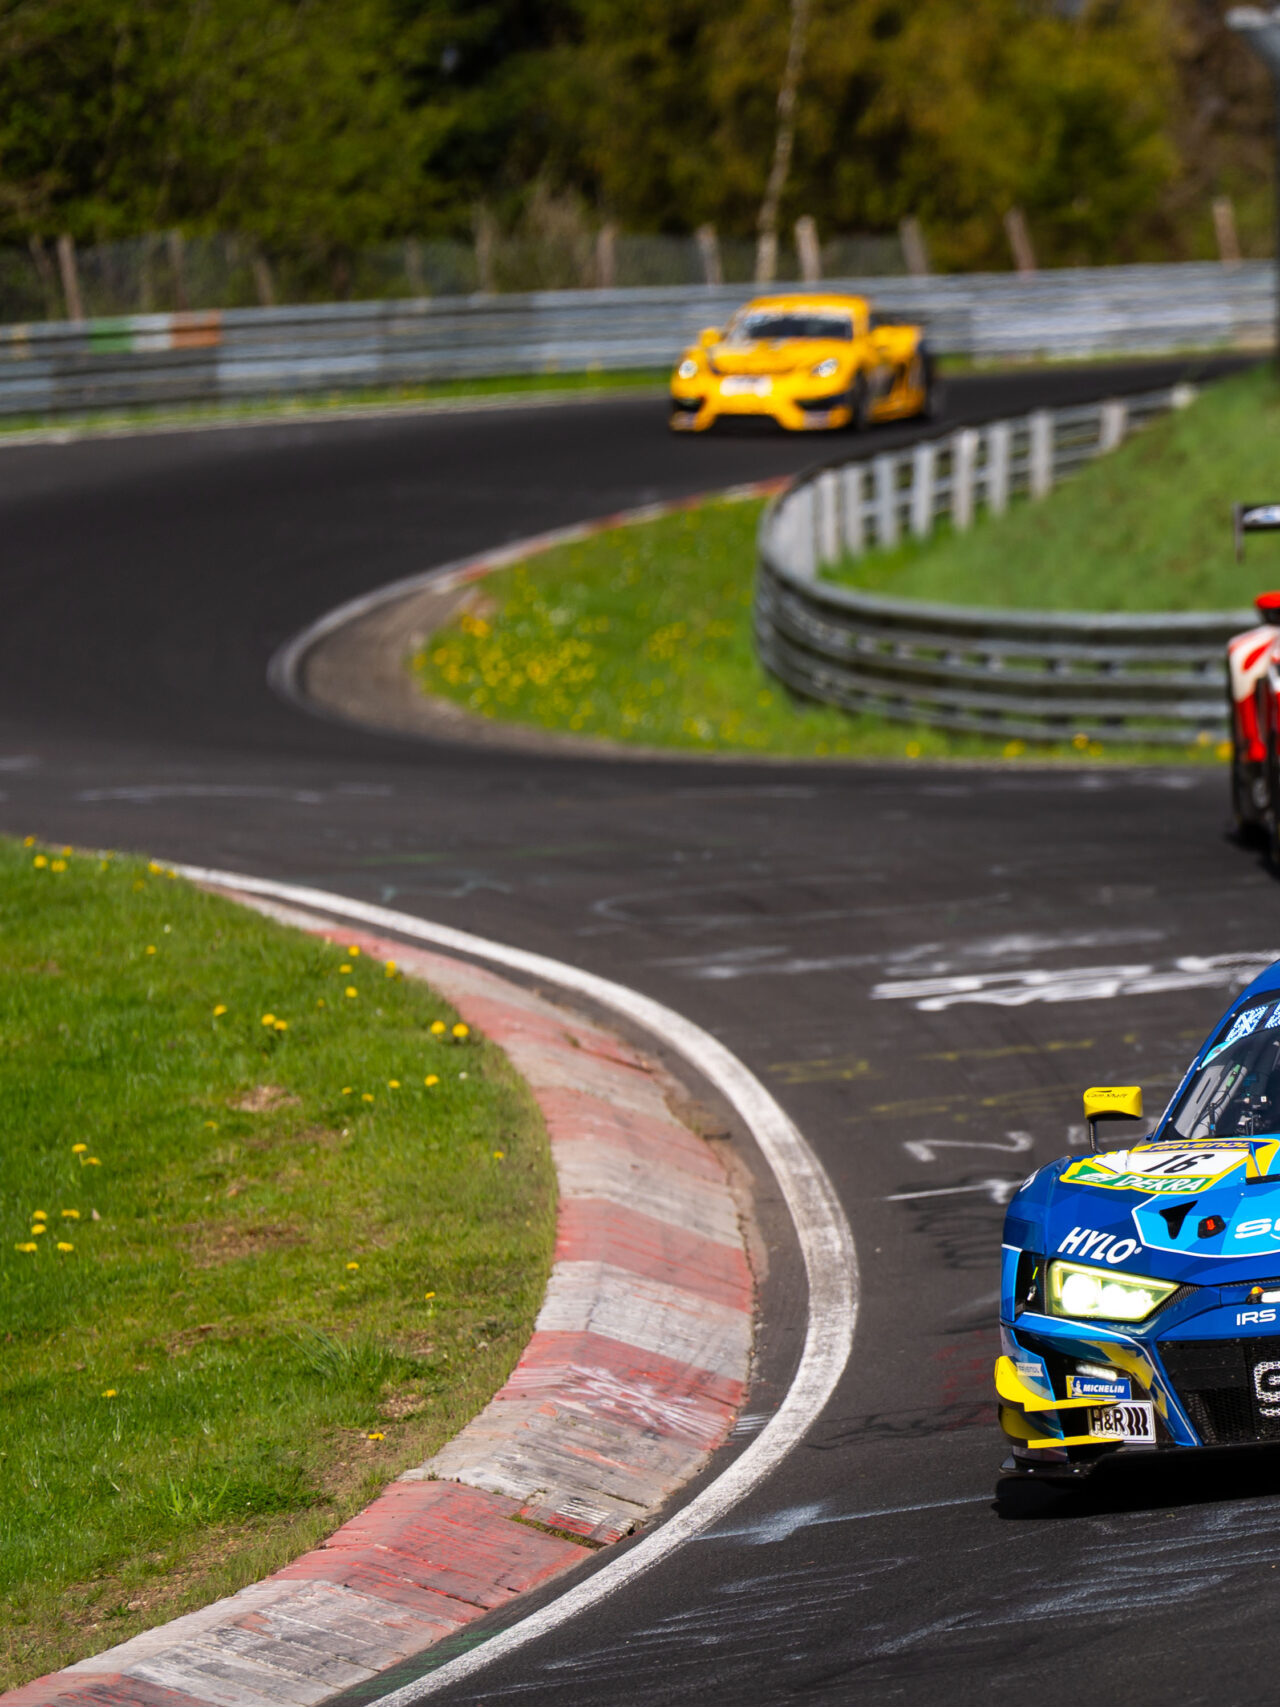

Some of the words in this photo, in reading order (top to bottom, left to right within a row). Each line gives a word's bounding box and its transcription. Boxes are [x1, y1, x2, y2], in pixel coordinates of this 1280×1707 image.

[1141, 1153, 1216, 1174] 16
[1113, 1175, 1205, 1192] DEKRA
[1236, 1309, 1277, 1326] IRS
[1083, 1383, 1125, 1394] MICHELIN
[1090, 1406, 1126, 1433] H&R
